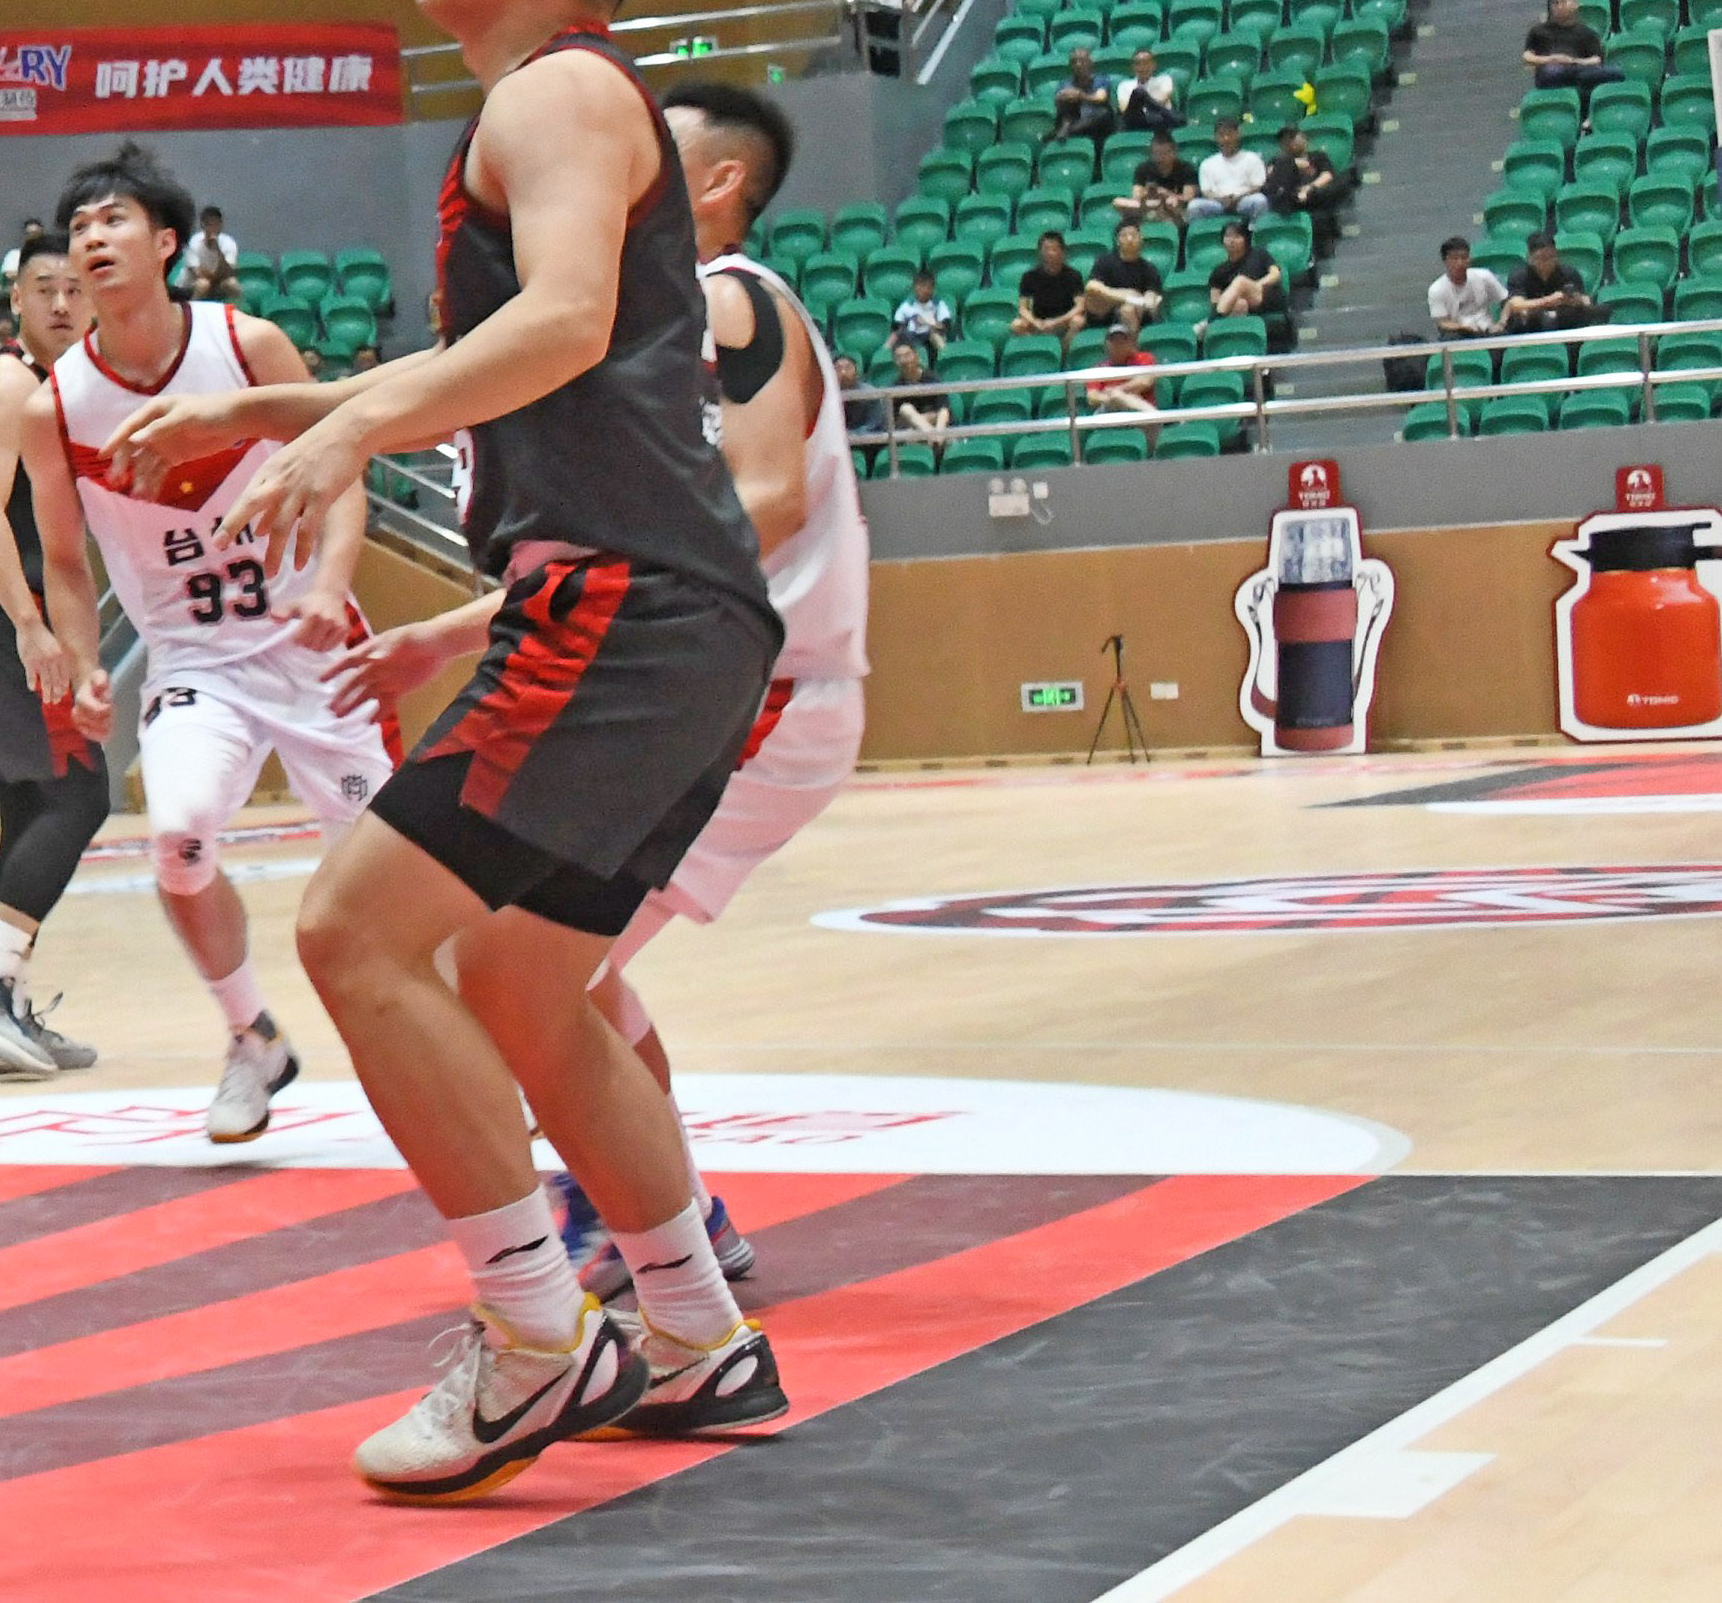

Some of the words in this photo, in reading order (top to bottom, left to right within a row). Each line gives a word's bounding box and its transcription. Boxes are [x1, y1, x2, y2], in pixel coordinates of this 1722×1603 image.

[95, 54, 373, 101] 呵护人类健康
[187, 558, 269, 624] 93
